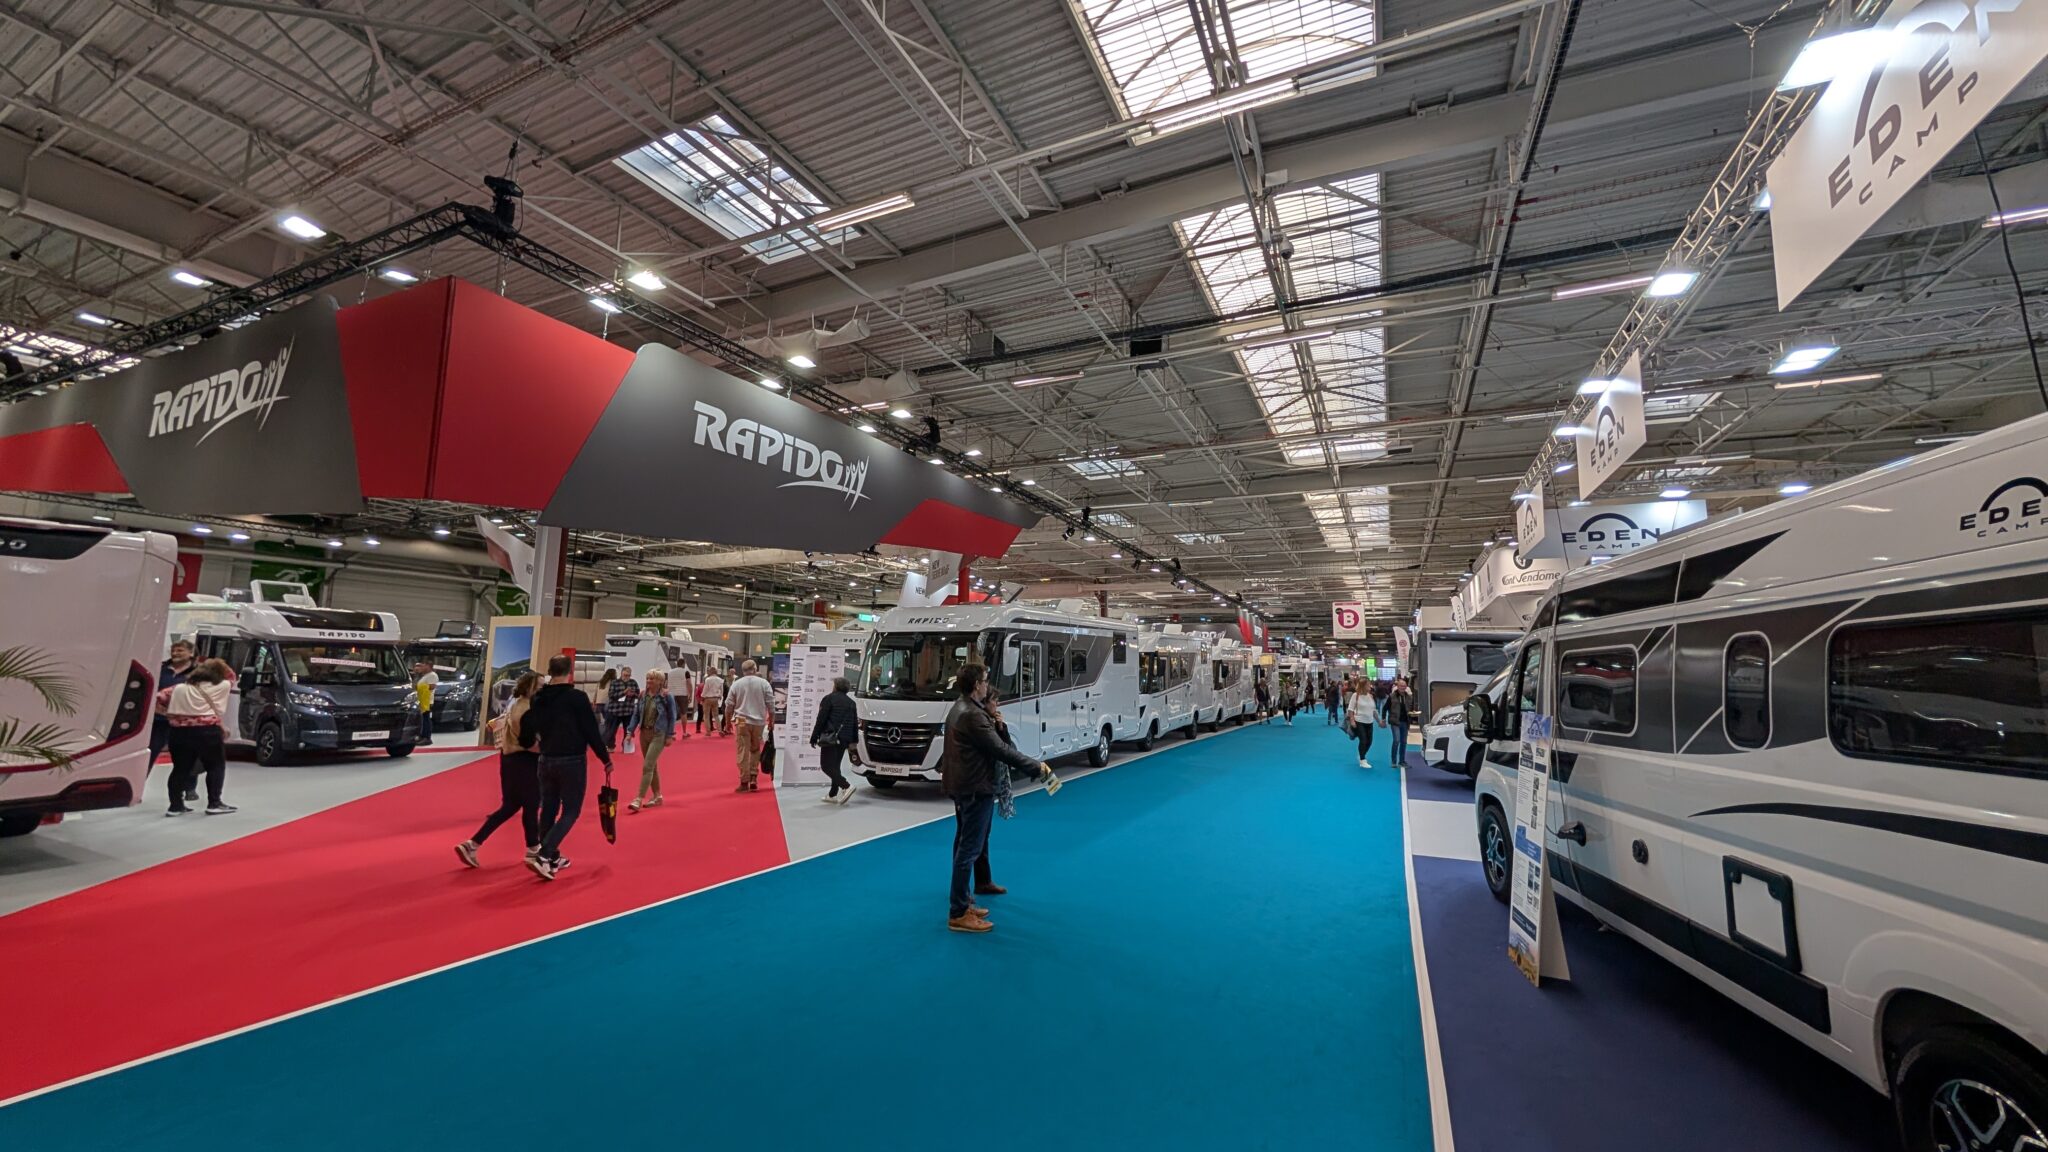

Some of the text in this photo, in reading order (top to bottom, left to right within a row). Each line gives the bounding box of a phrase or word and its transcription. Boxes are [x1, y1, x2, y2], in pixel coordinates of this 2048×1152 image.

[1858, 71, 1978, 205] CAMP
[1591, 416, 1624, 467] EDEN
[1597, 447, 1618, 473] CAMP
[1960, 498, 2042, 531] EDE
[1523, 515, 1537, 540] EDEN
[1562, 527, 1661, 544] EDEN
[1579, 542, 1641, 550] CAMP
[1343, 612, 1355, 627] B
[319, 631, 366, 639] RAPIDO
